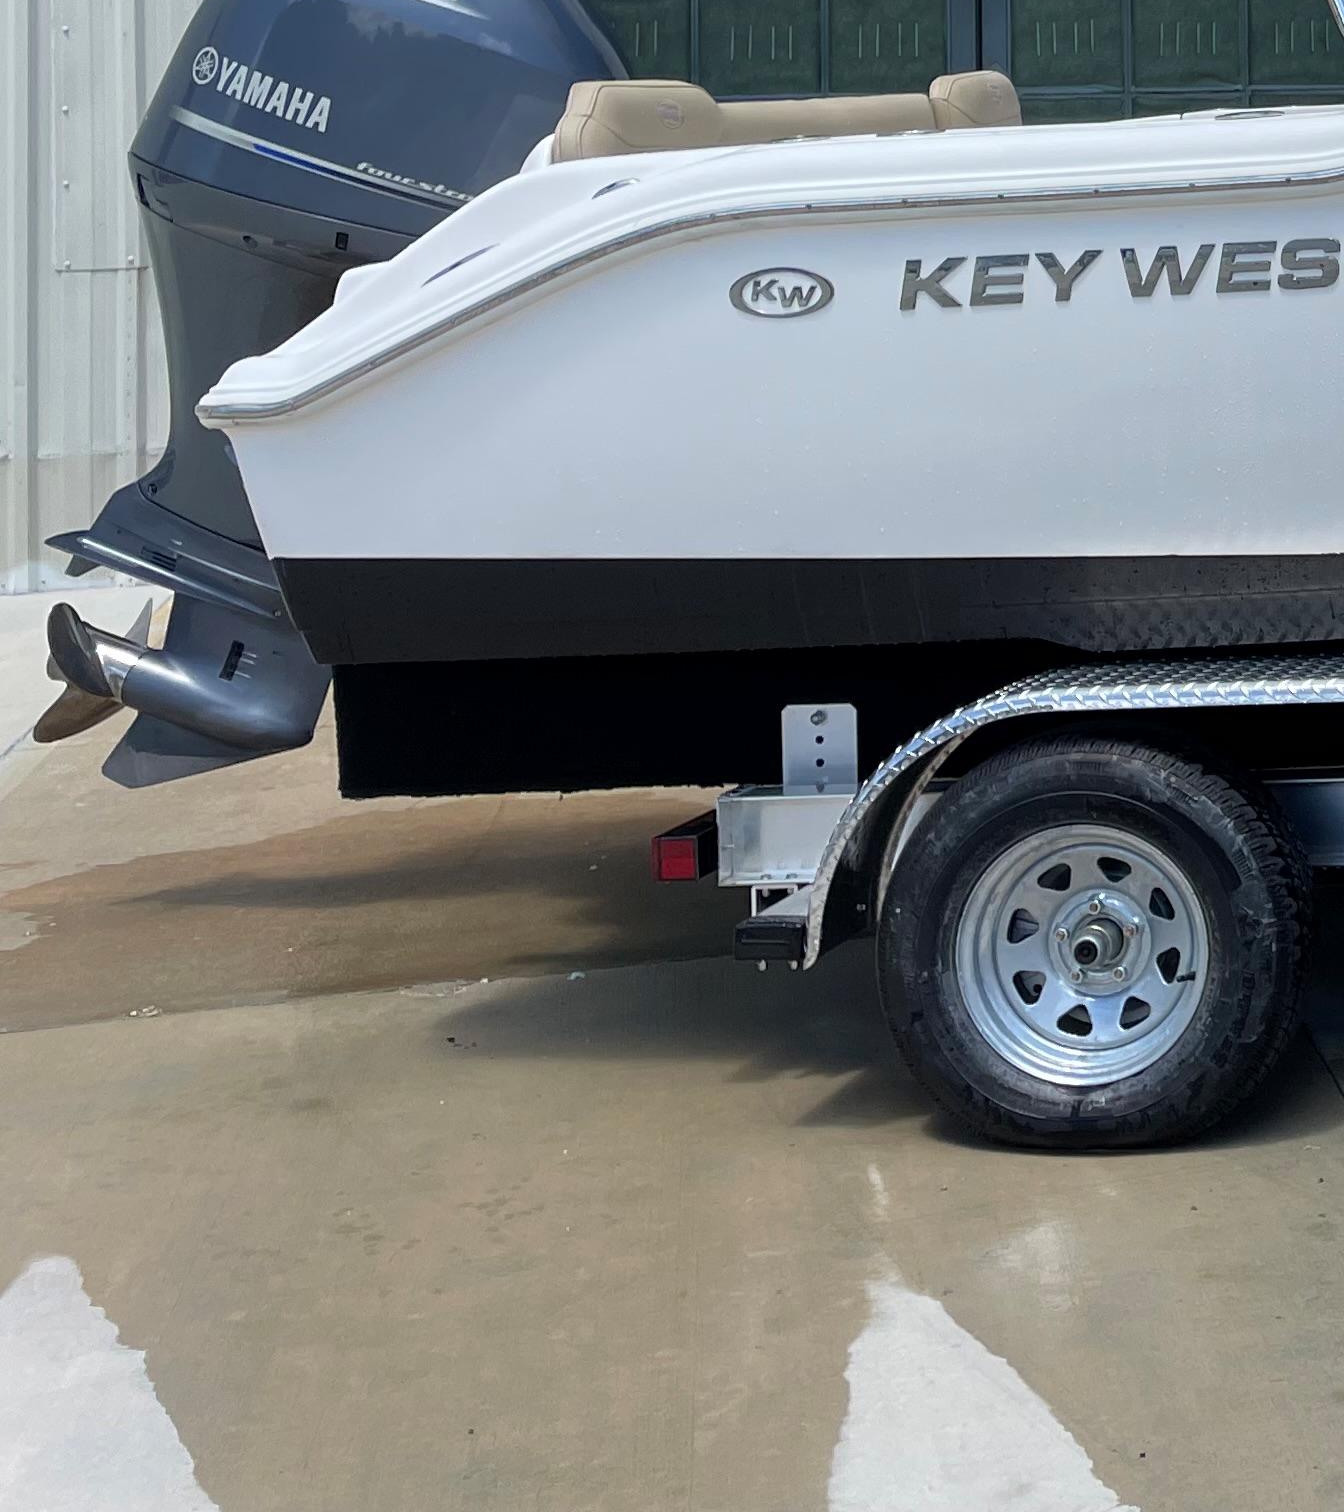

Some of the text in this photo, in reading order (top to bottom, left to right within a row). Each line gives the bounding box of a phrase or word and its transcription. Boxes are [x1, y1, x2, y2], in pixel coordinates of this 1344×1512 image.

[216, 56, 332, 133] YAMAHA
[750, 279, 817, 308] KW
[900, 249, 1103, 311] KEY
